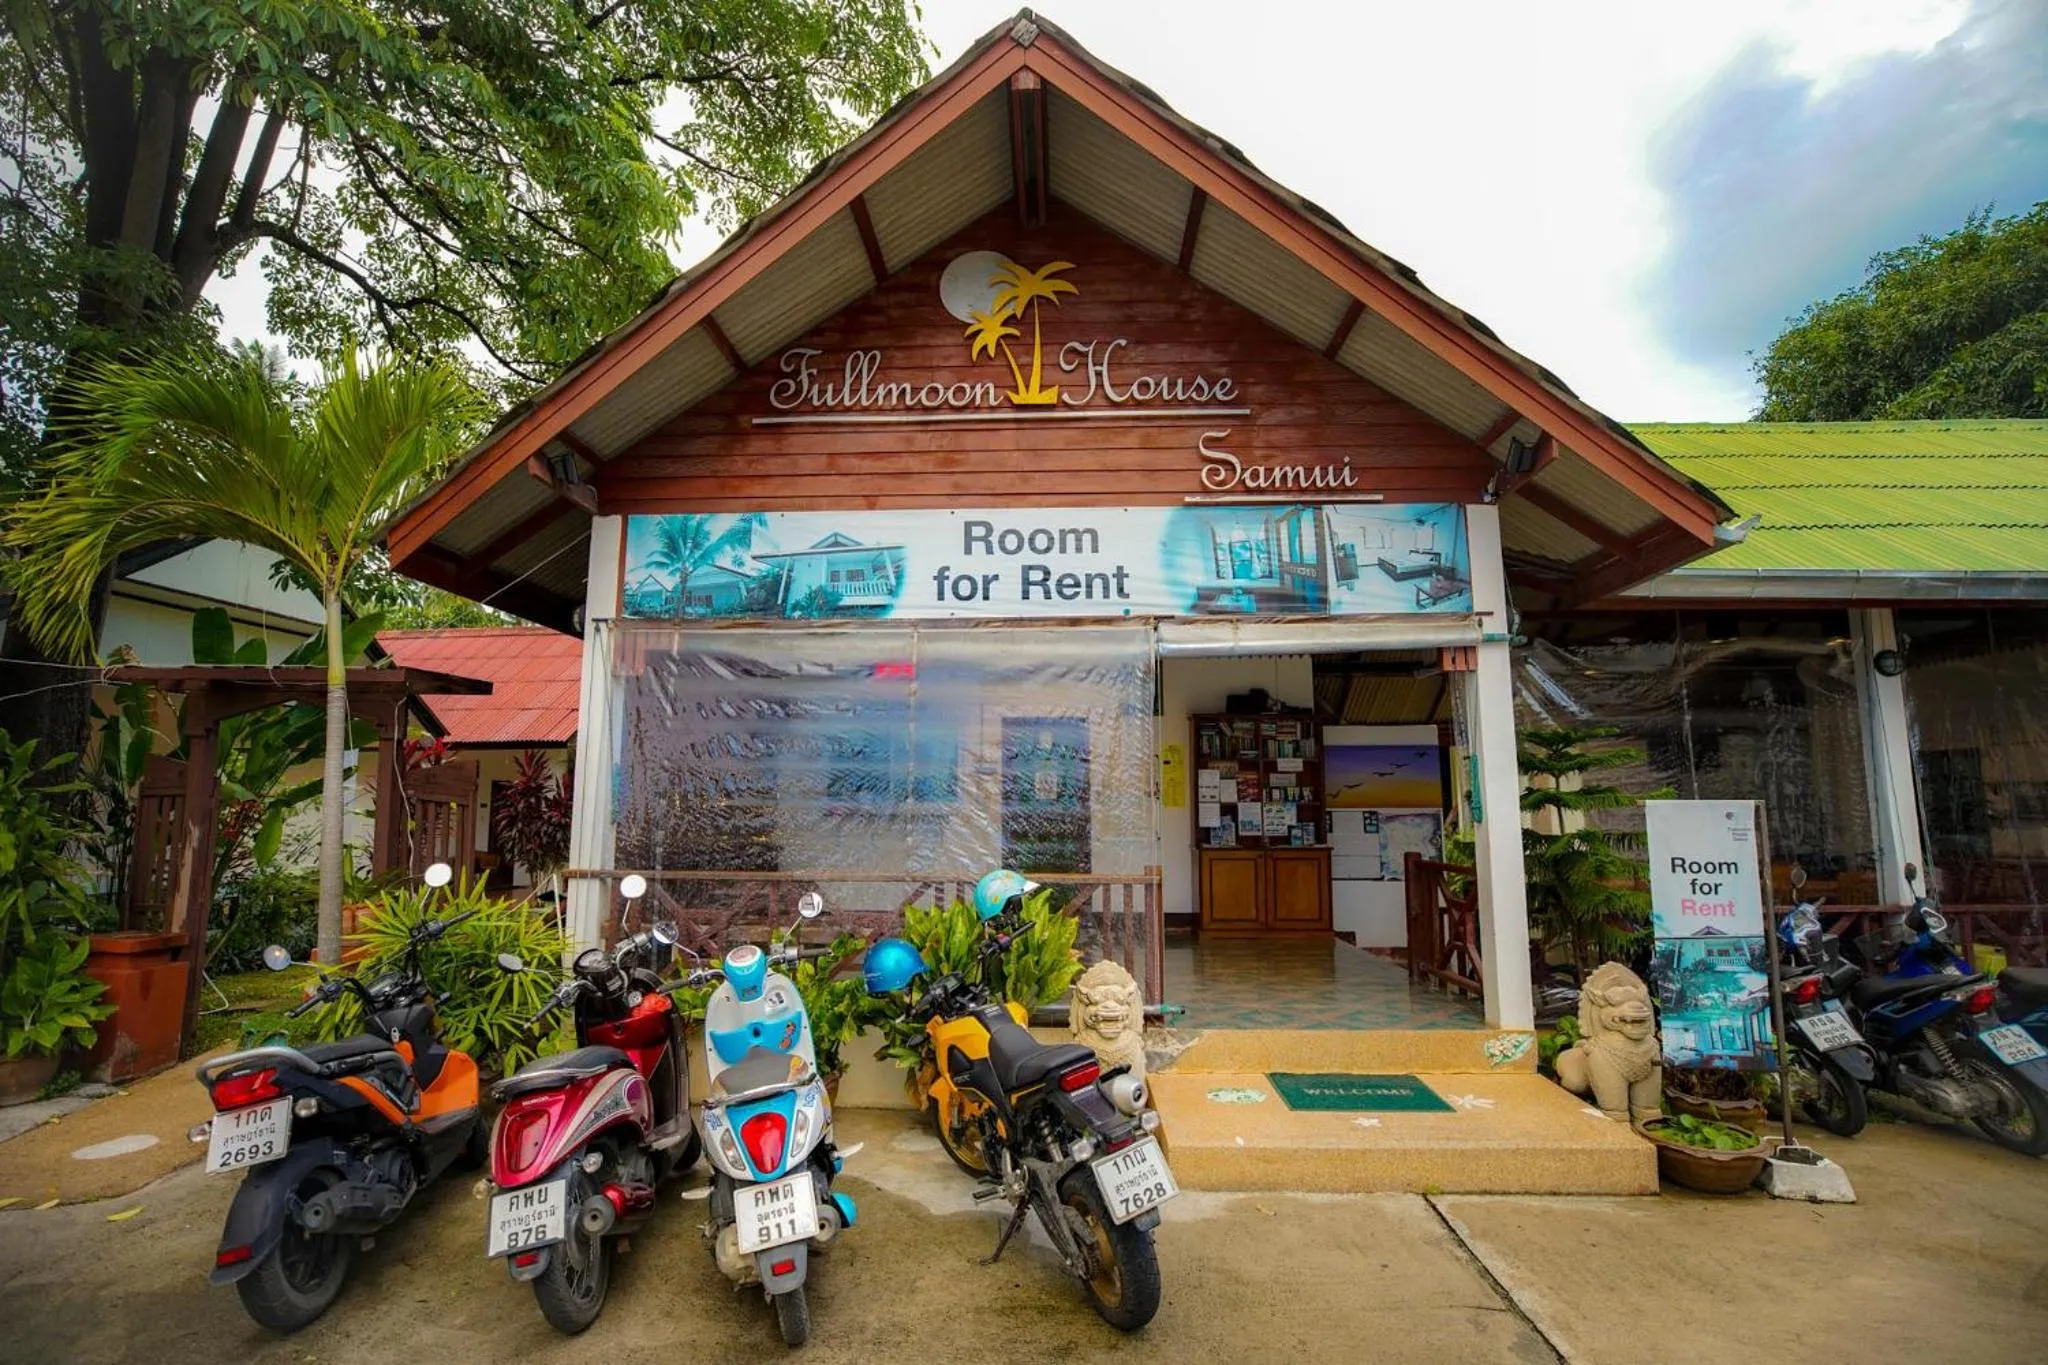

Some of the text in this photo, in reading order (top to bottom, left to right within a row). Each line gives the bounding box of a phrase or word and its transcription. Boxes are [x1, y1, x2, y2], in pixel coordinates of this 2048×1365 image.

[769, 339, 1239, 409] Fullmoon House
[1199, 428, 1358, 490] Samui
[964, 521, 1099, 555] Room
[933, 564, 1130, 601] for Rent
[1671, 857, 1738, 874] Room
[1690, 878, 1723, 895] for
[1681, 899, 1736, 917] Rent
[1303, 1088, 1415, 1096] WELCOME
[219, 1140, 274, 1168] 2693
[1120, 1182, 1167, 1215] 7628
[508, 1224, 547, 1248] 876
[758, 1219, 797, 1244] 911
